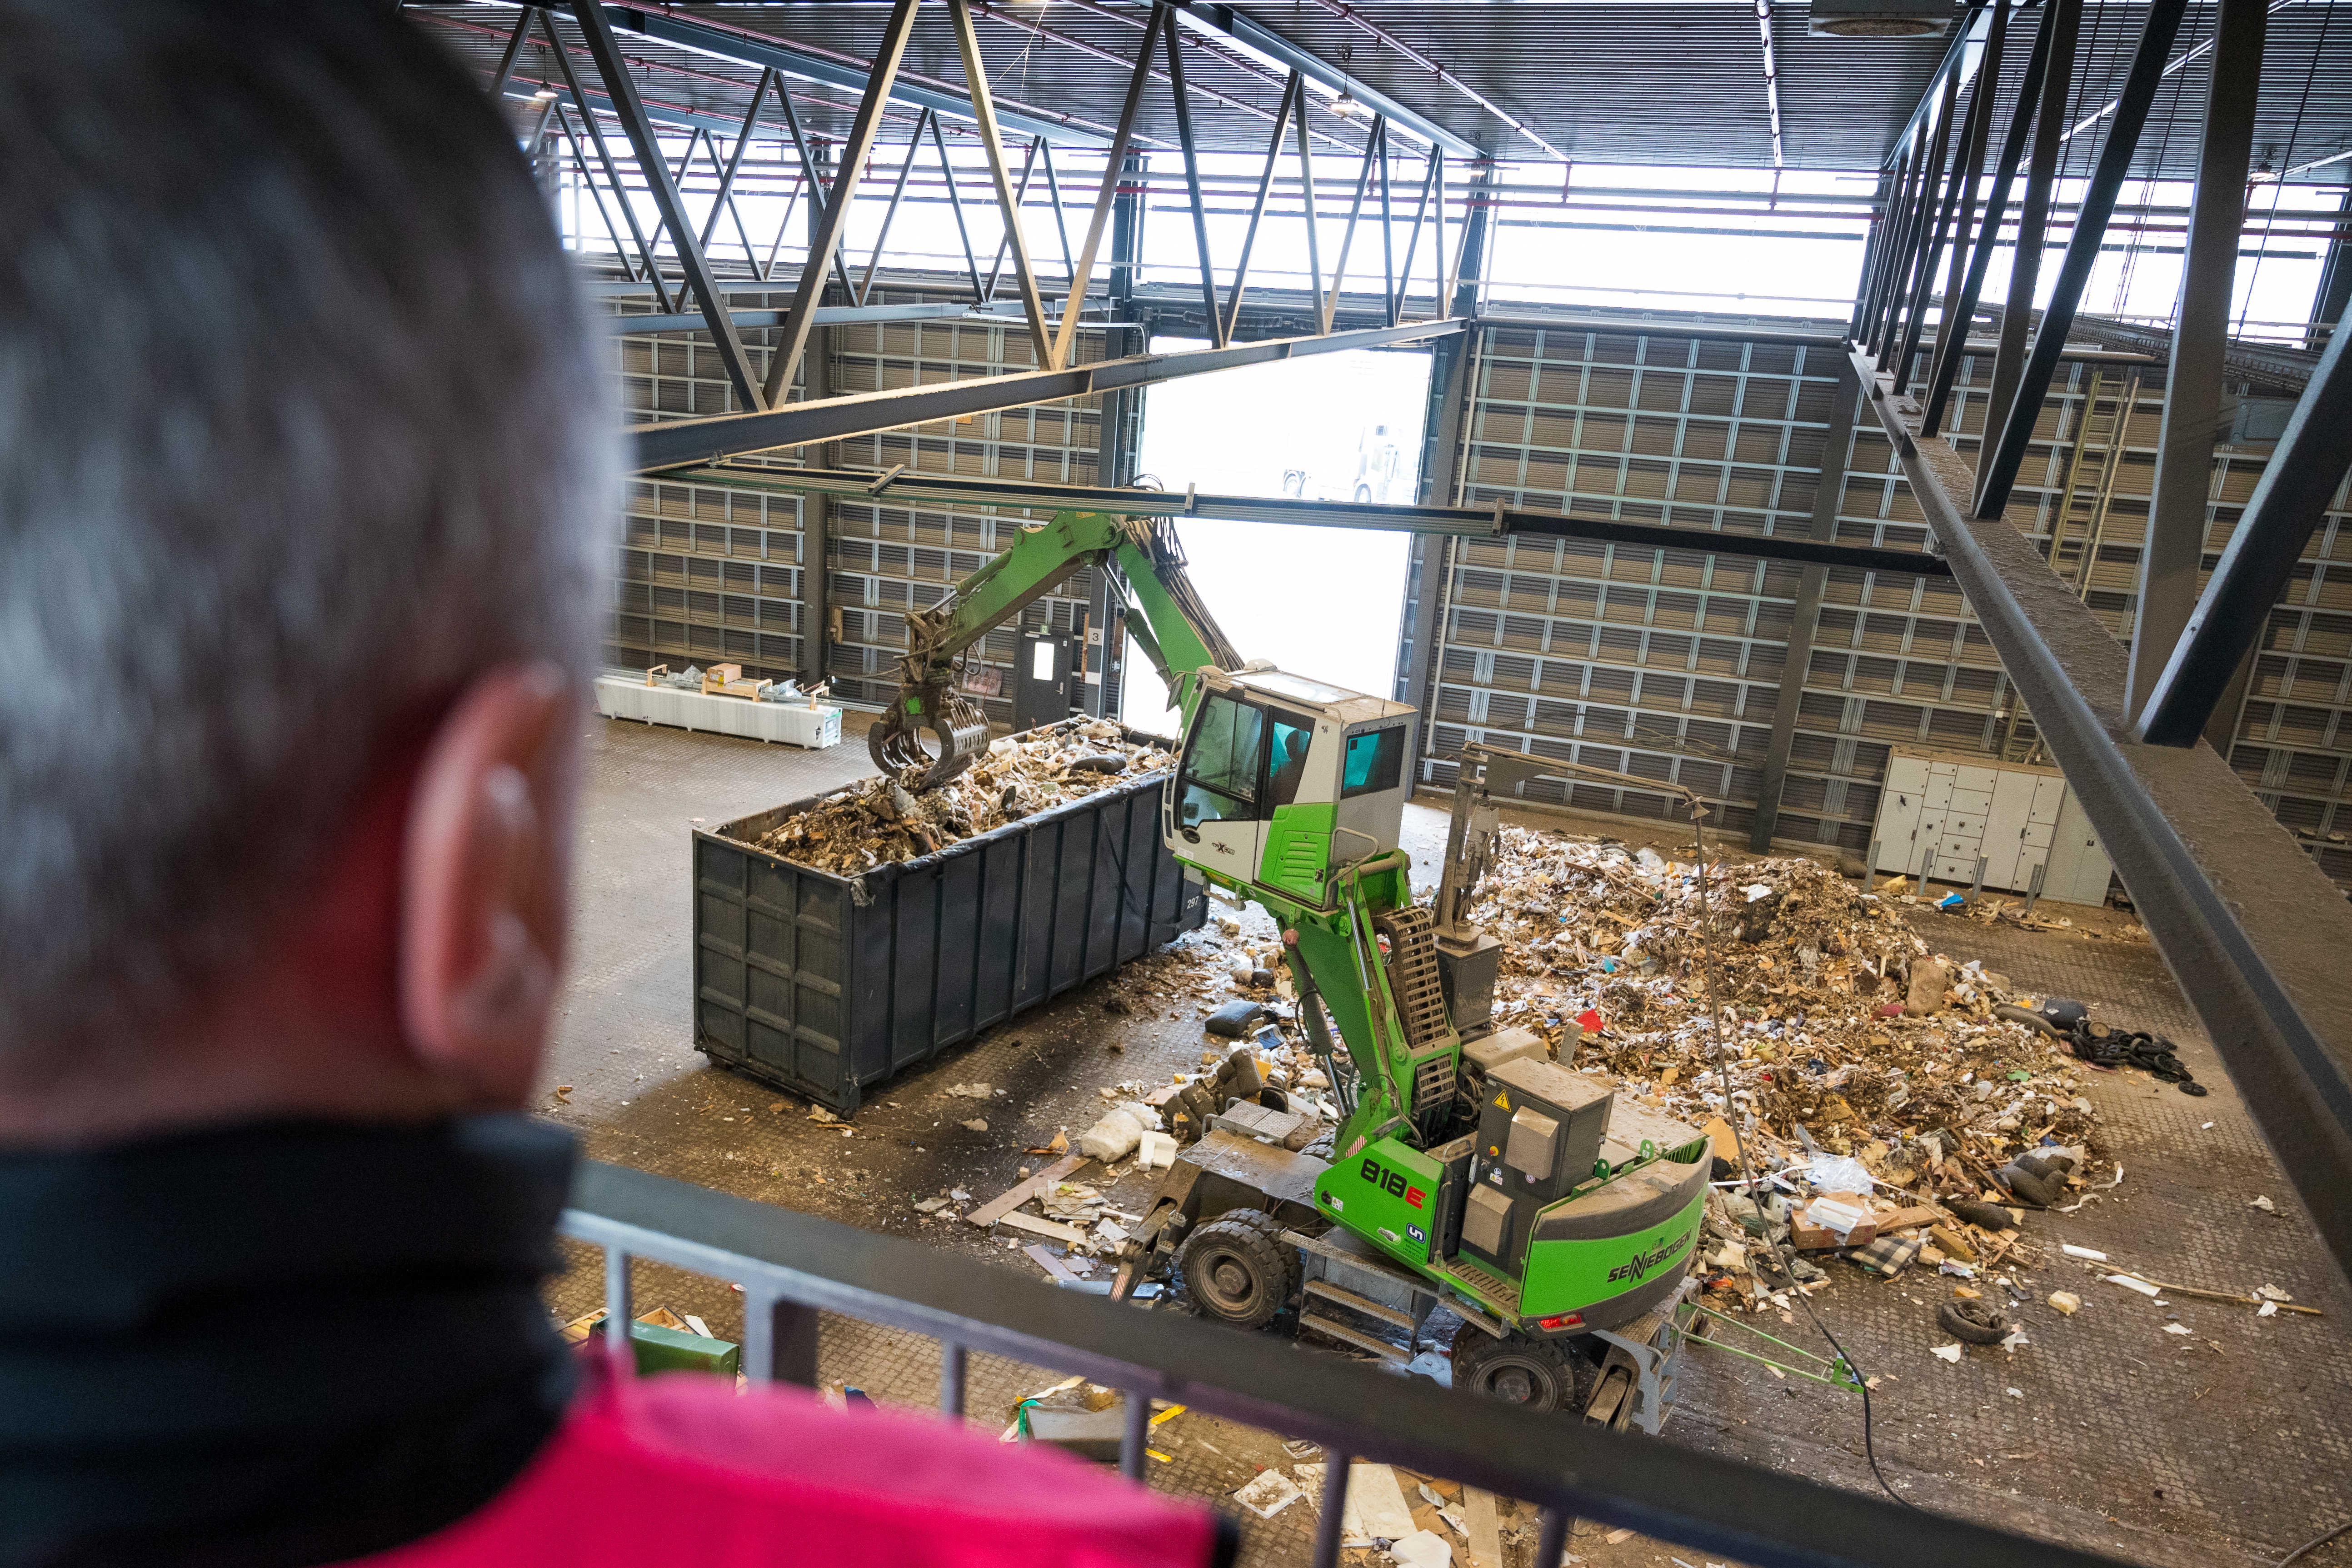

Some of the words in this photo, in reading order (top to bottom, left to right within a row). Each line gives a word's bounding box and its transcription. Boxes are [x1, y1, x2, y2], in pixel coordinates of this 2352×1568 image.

[1092, 633, 1099, 641] 3
[1187, 895, 1199, 909] 297
[1360, 1158, 1427, 1210] 818E
[1607, 1226, 1691, 1283] SENNEBOGEN
